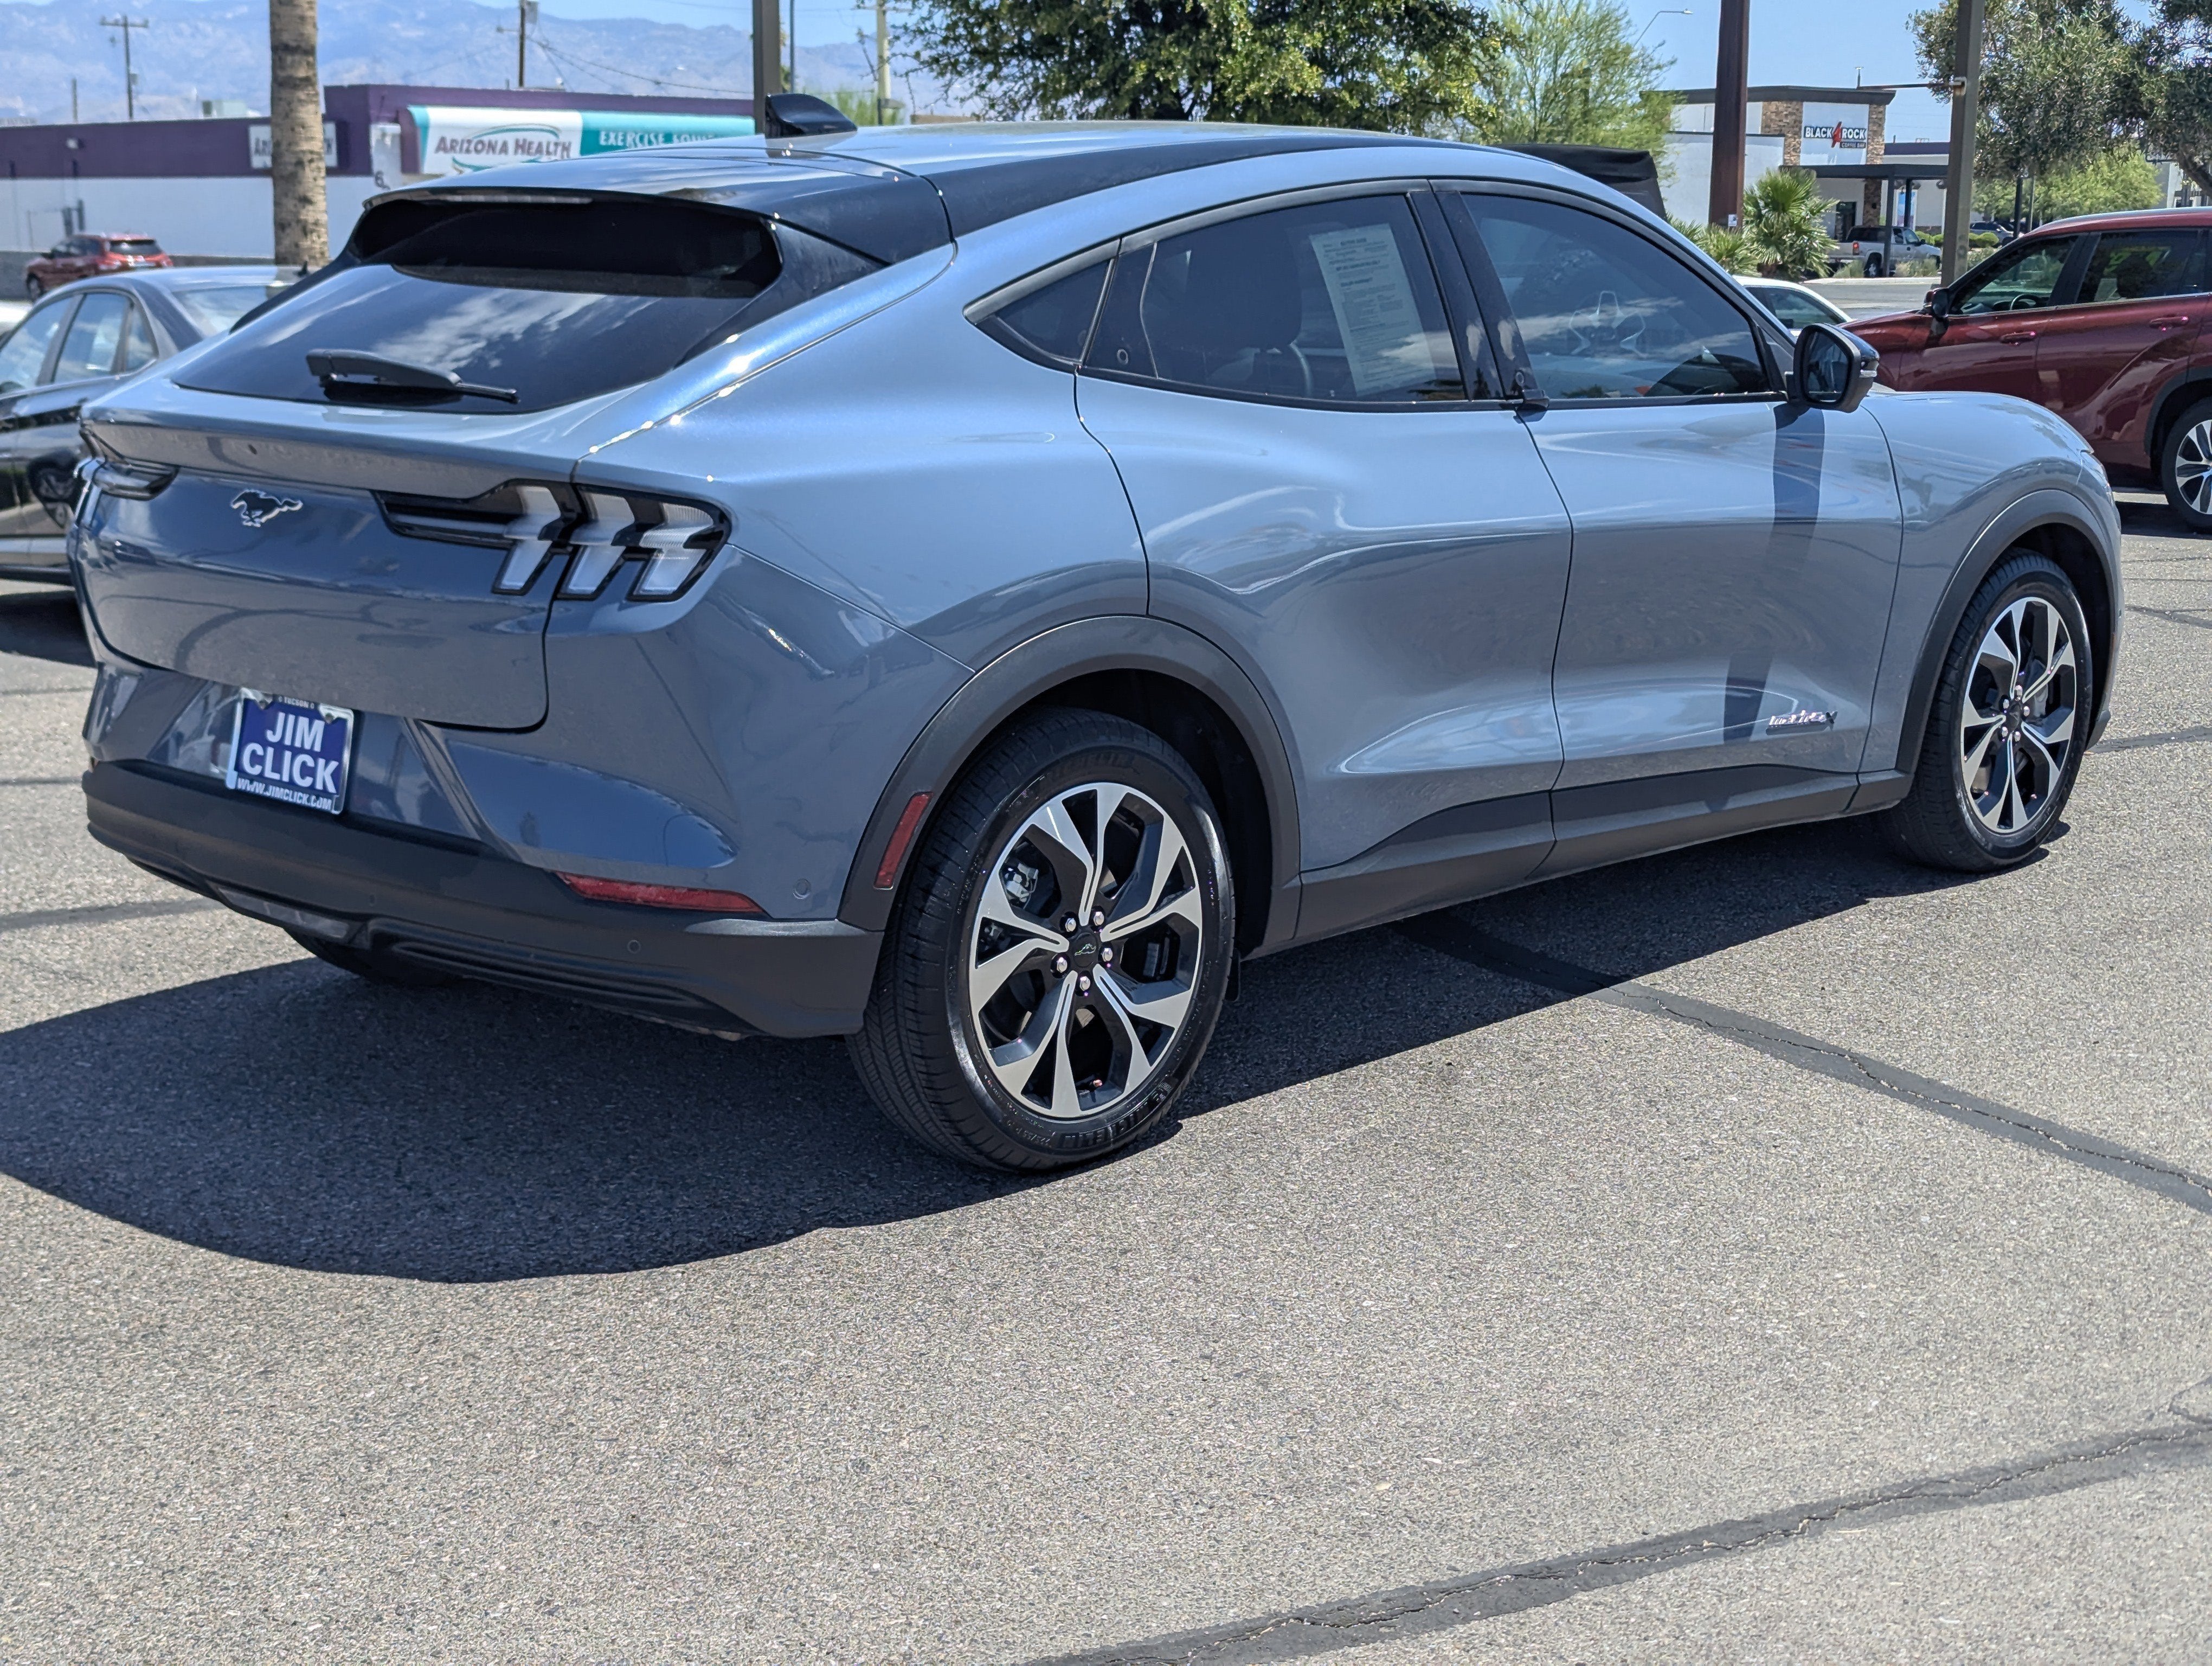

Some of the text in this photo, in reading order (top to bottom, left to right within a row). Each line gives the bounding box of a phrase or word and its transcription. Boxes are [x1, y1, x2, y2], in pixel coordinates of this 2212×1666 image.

[599, 130, 665, 148] EXERCISE
[1805, 127, 1866, 139] BLACK ROCK
[434, 136, 571, 159] ARIZONA HEALTH
[266, 712, 325, 752] JIM
[242, 742, 339, 793] CLICK
